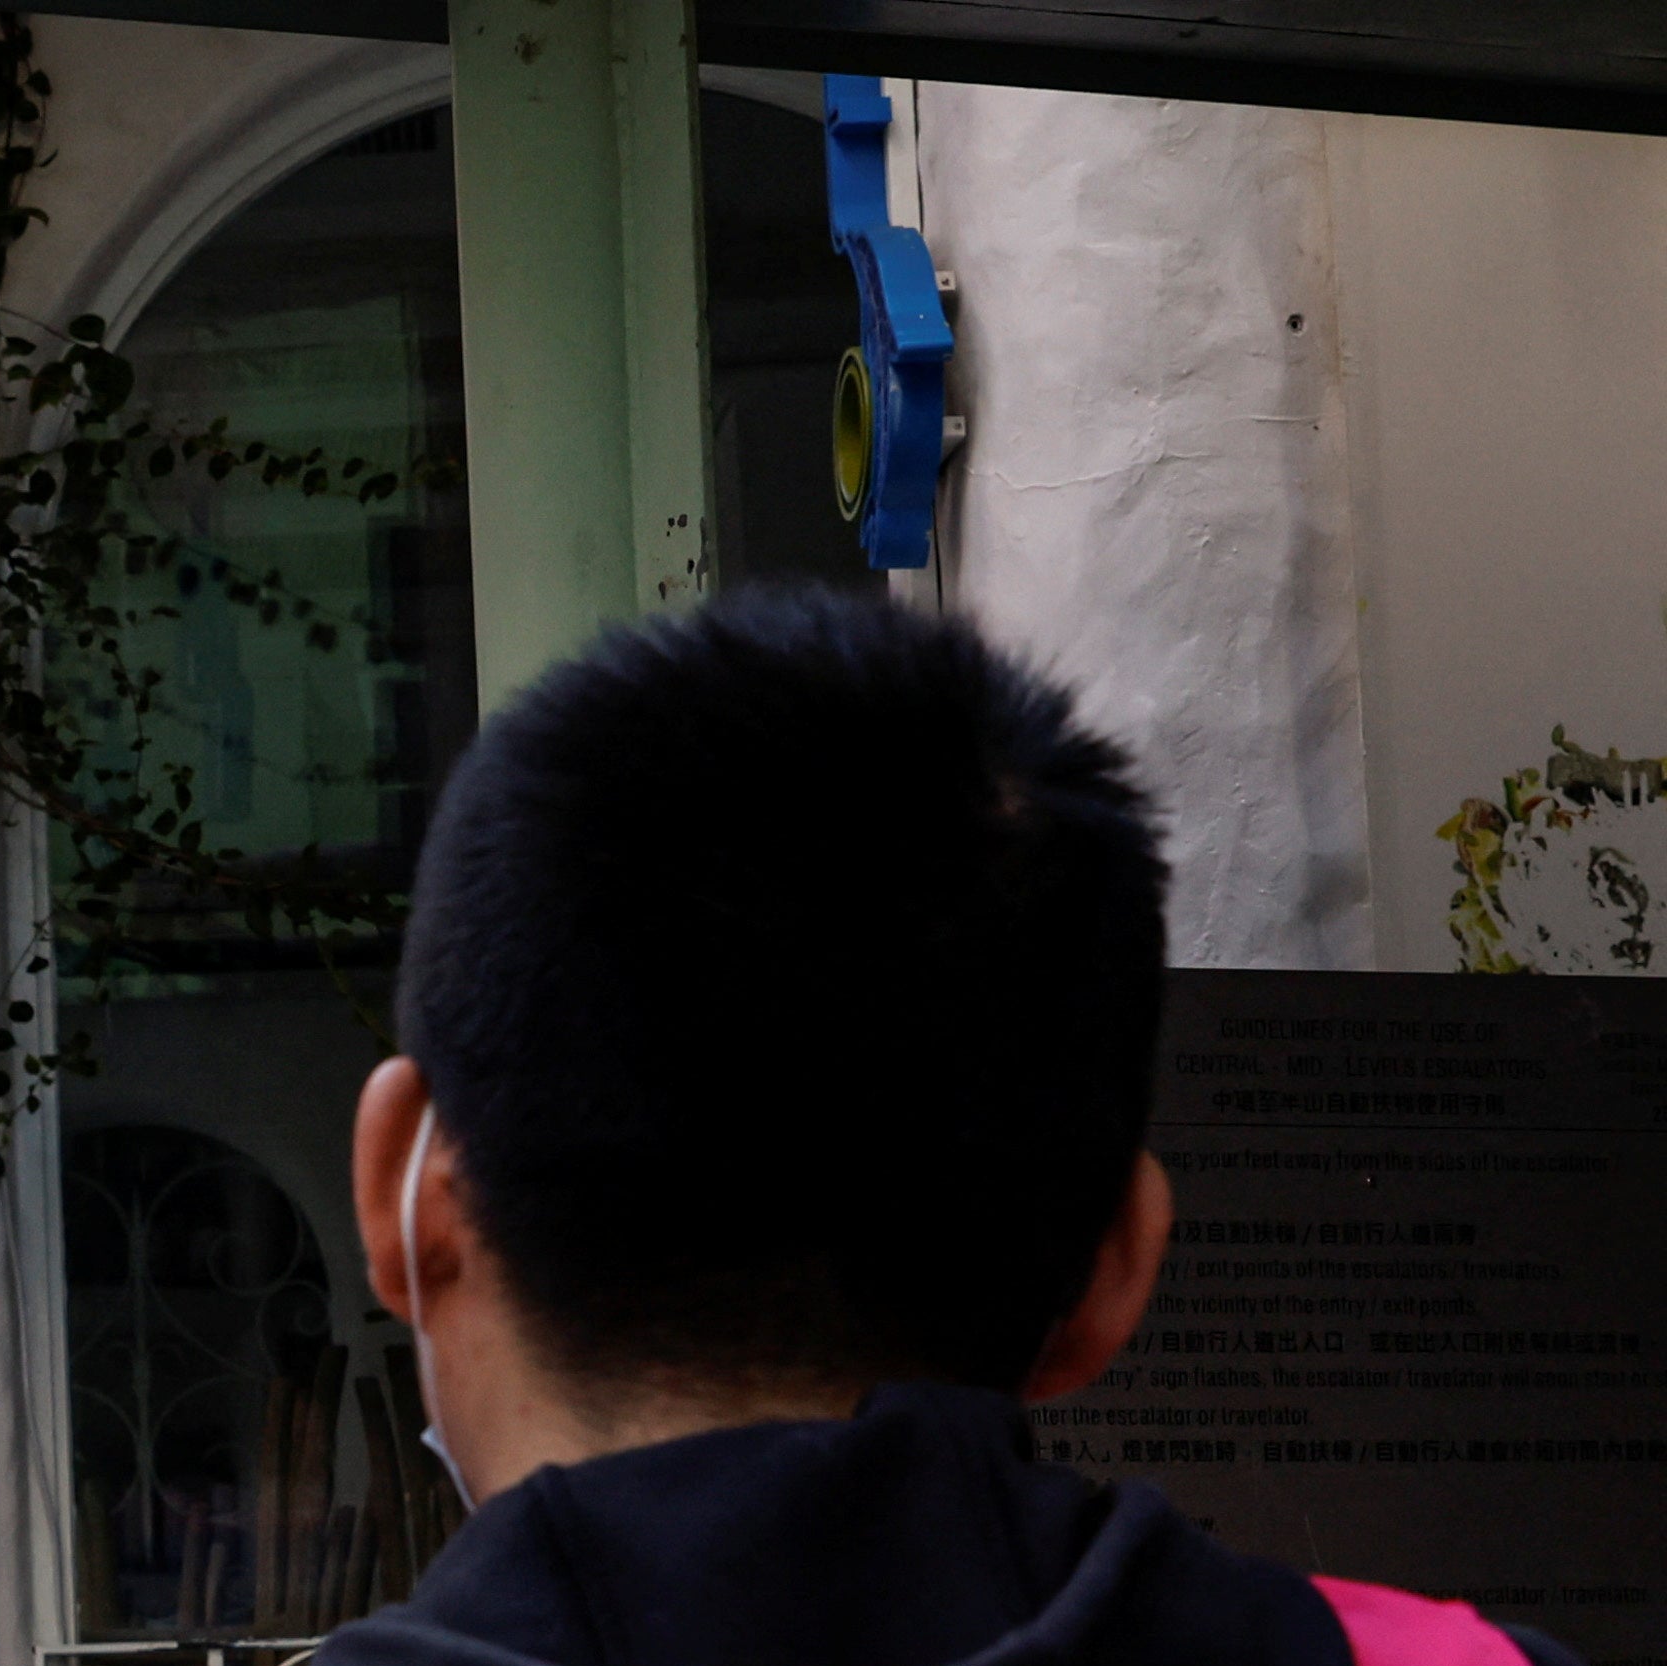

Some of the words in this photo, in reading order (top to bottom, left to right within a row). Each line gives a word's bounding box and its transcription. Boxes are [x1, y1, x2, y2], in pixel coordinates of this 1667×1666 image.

[1220, 1017, 1334, 1041] GUIDELINES
[1342, 1019, 1376, 1042] FOR
[1387, 1020, 1422, 1042] THE
[1430, 1021, 1465, 1043] USE
[1475, 1022, 1500, 1043] OF
[1175, 1053, 1265, 1075] CENTRAL
[1287, 1056, 1324, 1076] MID
[1424, 1058, 1547, 1081] ESCALATORS
[1161, 1152, 1193, 1173] eep
[1198, 1151, 1239, 1172] your
[1244, 1149, 1279, 1169] feet
[1284, 1152, 1332, 1173] away
[1337, 1149, 1380, 1171] from
[1385, 1150, 1414, 1171] the
[1419, 1150, 1466, 1171] sides
[1472, 1151, 1492, 1171] of
[1494, 1151, 1523, 1171] the
[1526, 1151, 1609, 1172] escalator
[1196, 1259, 1228, 1280] exit
[1233, 1260, 1290, 1282] points
[1296, 1259, 1317, 1279] of
[1319, 1259, 1348, 1280] the
[1351, 1259, 1447, 1281] escalators
[1190, 1296, 1257, 1318] vicinity
[1285, 1296, 1315, 1316] the
[1319, 1297, 1367, 1319] entry
[1383, 1298, 1416, 1316] exit
[1149, 1368, 1189, 1390] sign
[1272, 1367, 1301, 1388] the
[1305, 1368, 1390, 1389] escalator
[1408, 1368, 1494, 1389] travelator
[1501, 1370, 1529, 1389] will
[1534, 1373, 1578, 1389] soon
[1031, 1407, 1068, 1426] nter
[1071, 1406, 1102, 1426] the
[1106, 1406, 1193, 1426] escalator
[1197, 1409, 1217, 1426] or
